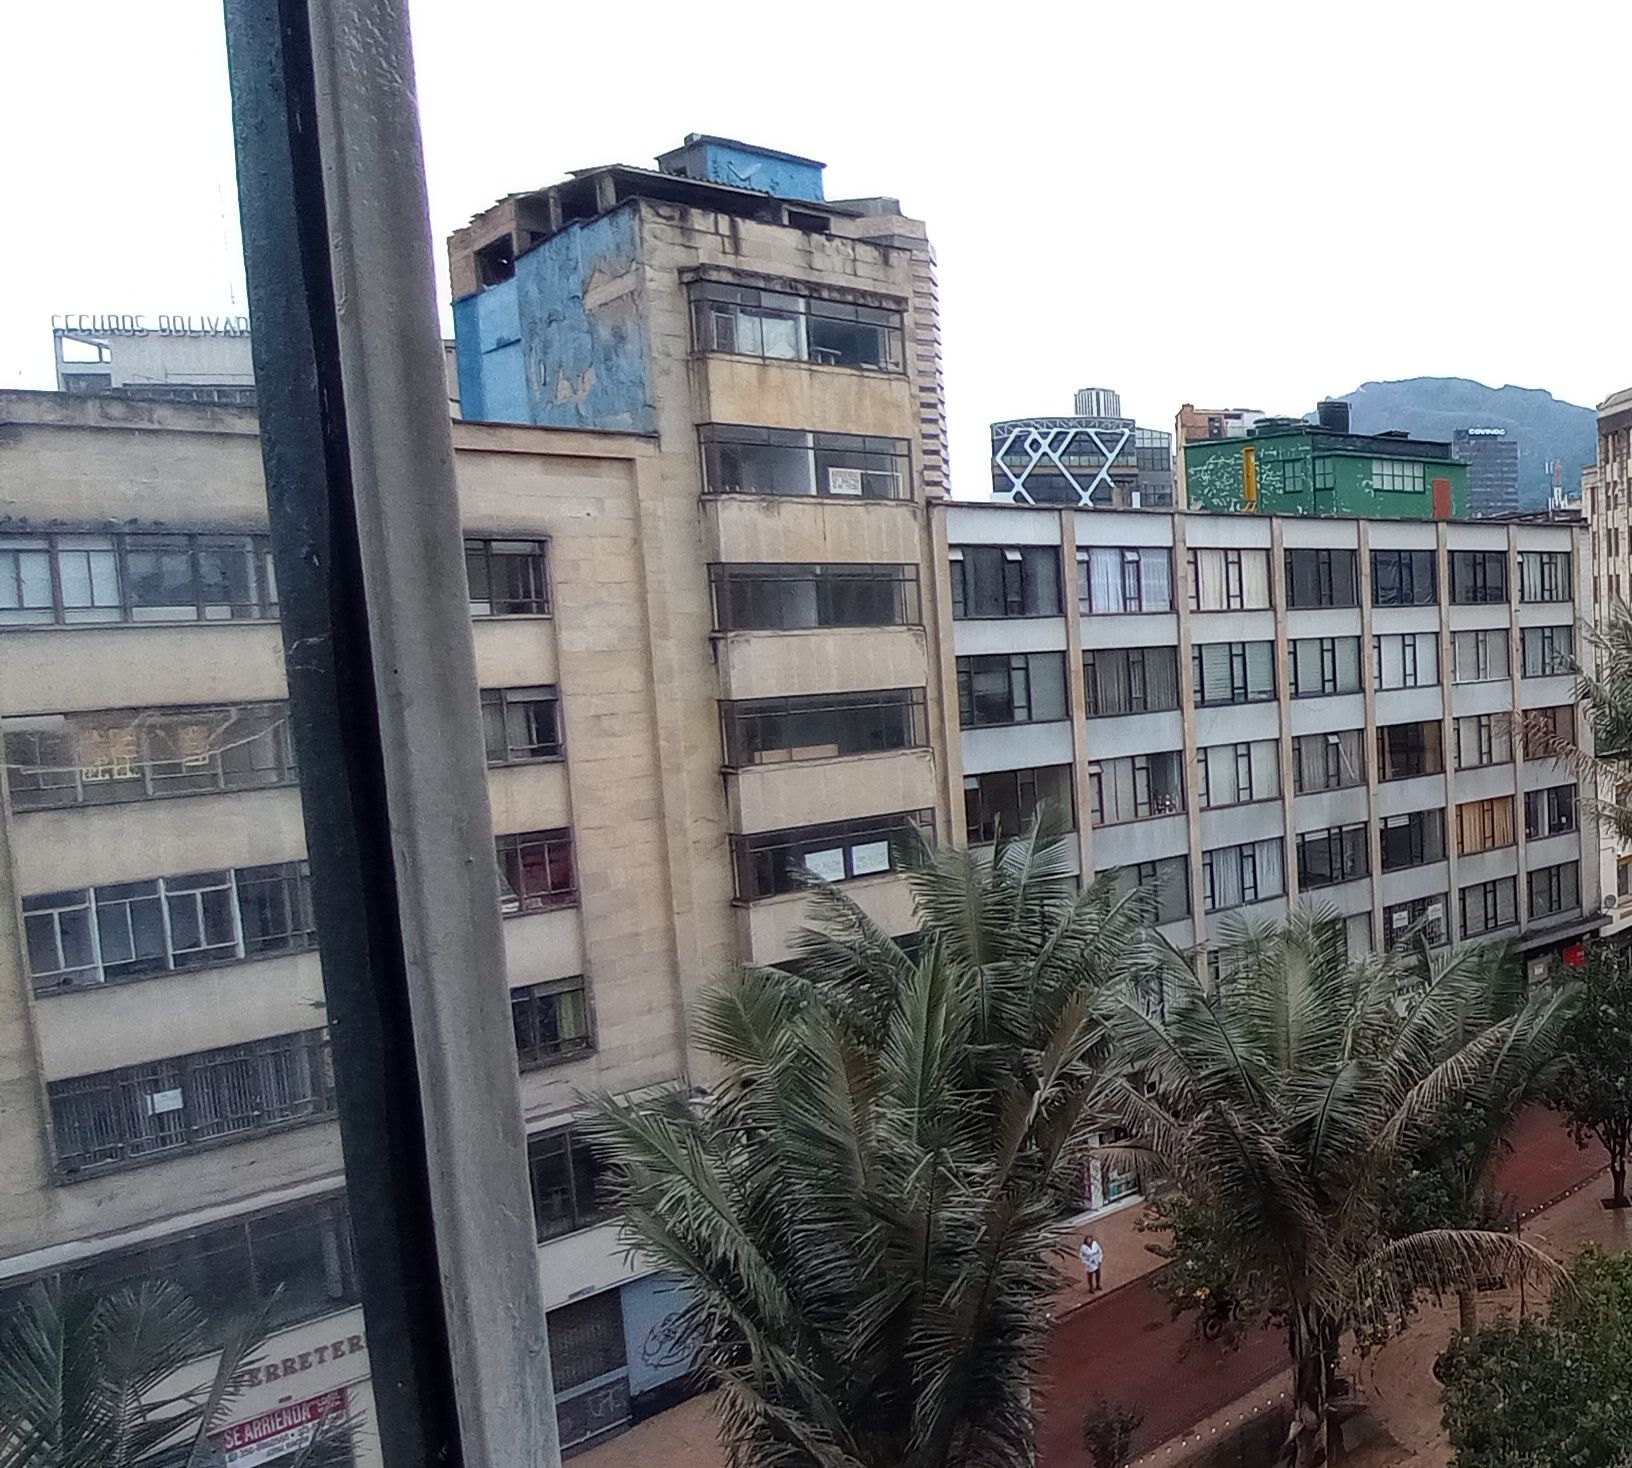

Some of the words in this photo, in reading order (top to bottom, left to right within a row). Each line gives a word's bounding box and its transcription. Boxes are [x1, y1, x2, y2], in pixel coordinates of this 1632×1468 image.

[235, 1334, 366, 1392] ERRETER
[224, 1424, 243, 1449] SE
[243, 1402, 312, 1439] ARRIENDA
